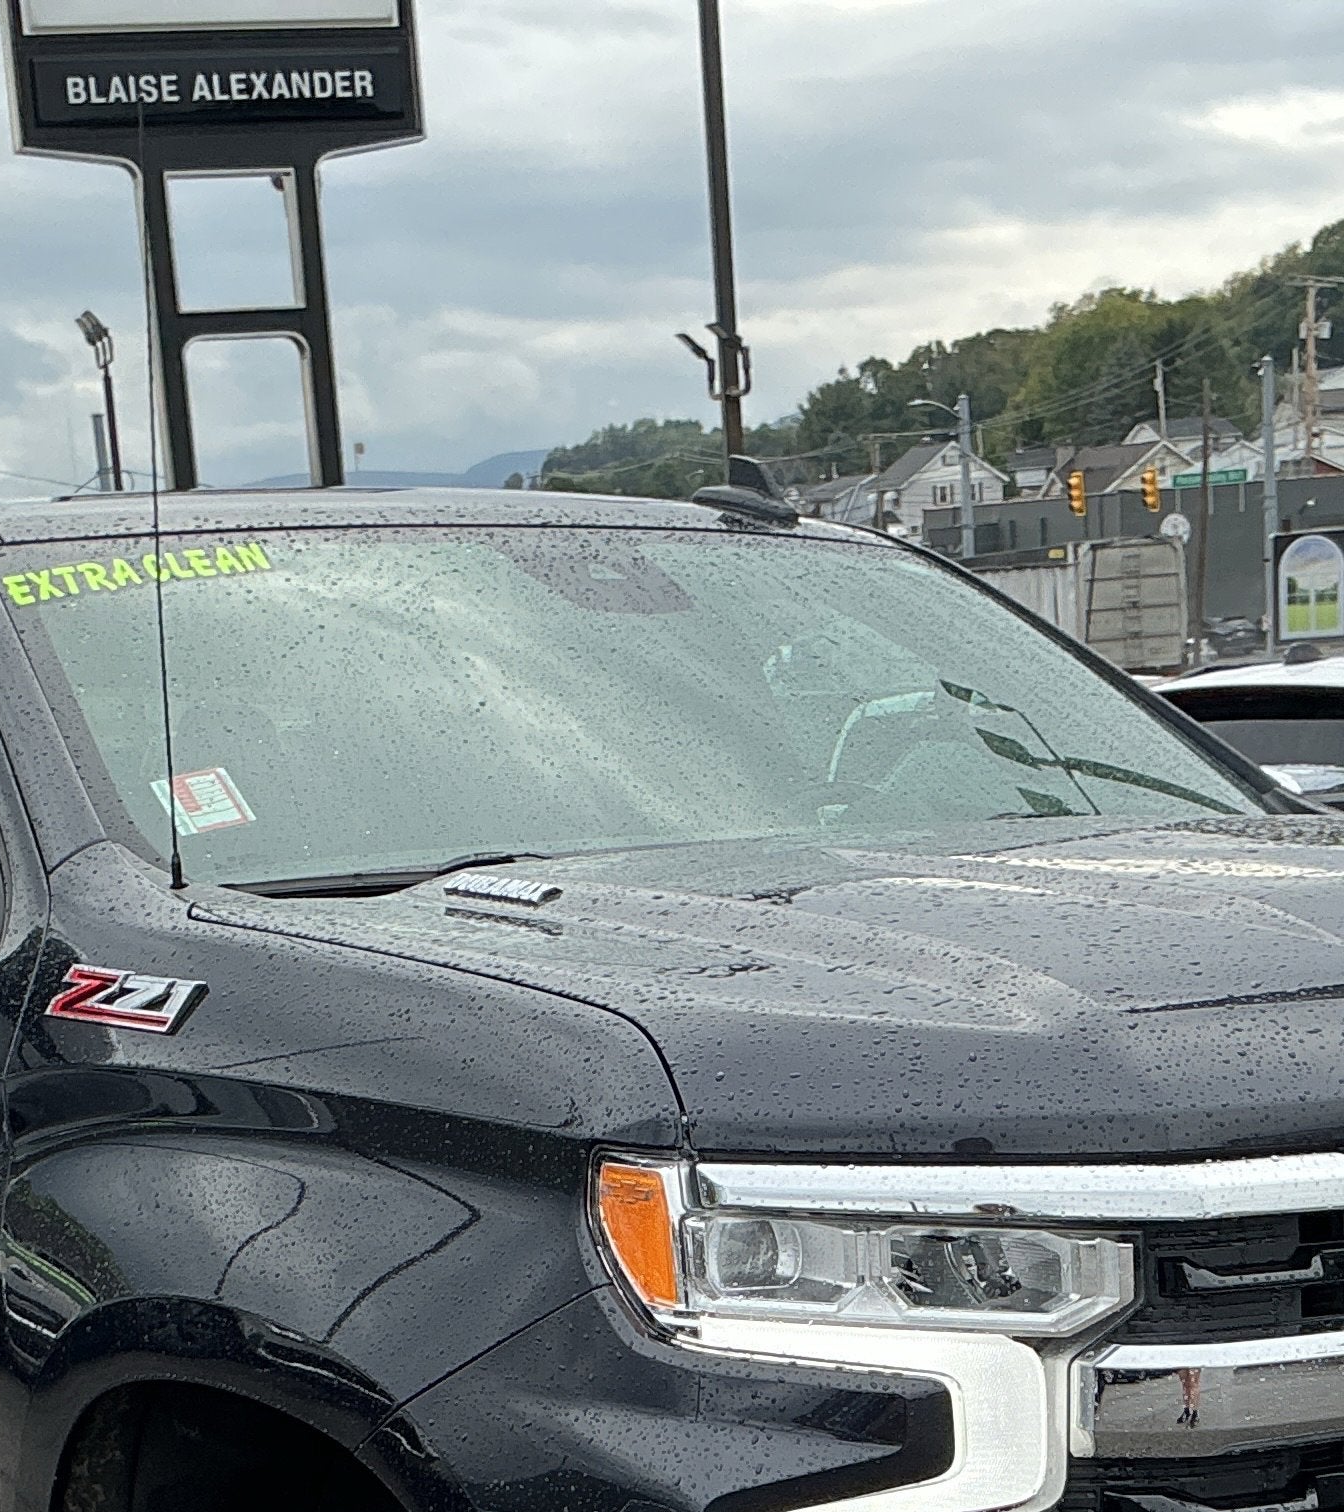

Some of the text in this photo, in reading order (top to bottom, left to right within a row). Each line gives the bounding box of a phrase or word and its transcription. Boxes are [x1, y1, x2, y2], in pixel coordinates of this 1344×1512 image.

[65, 70, 375, 105] BLAISE ALEXANDER
[3, 542, 272, 606] EXTRA CLEAN
[43, 962, 208, 1034] Z71
